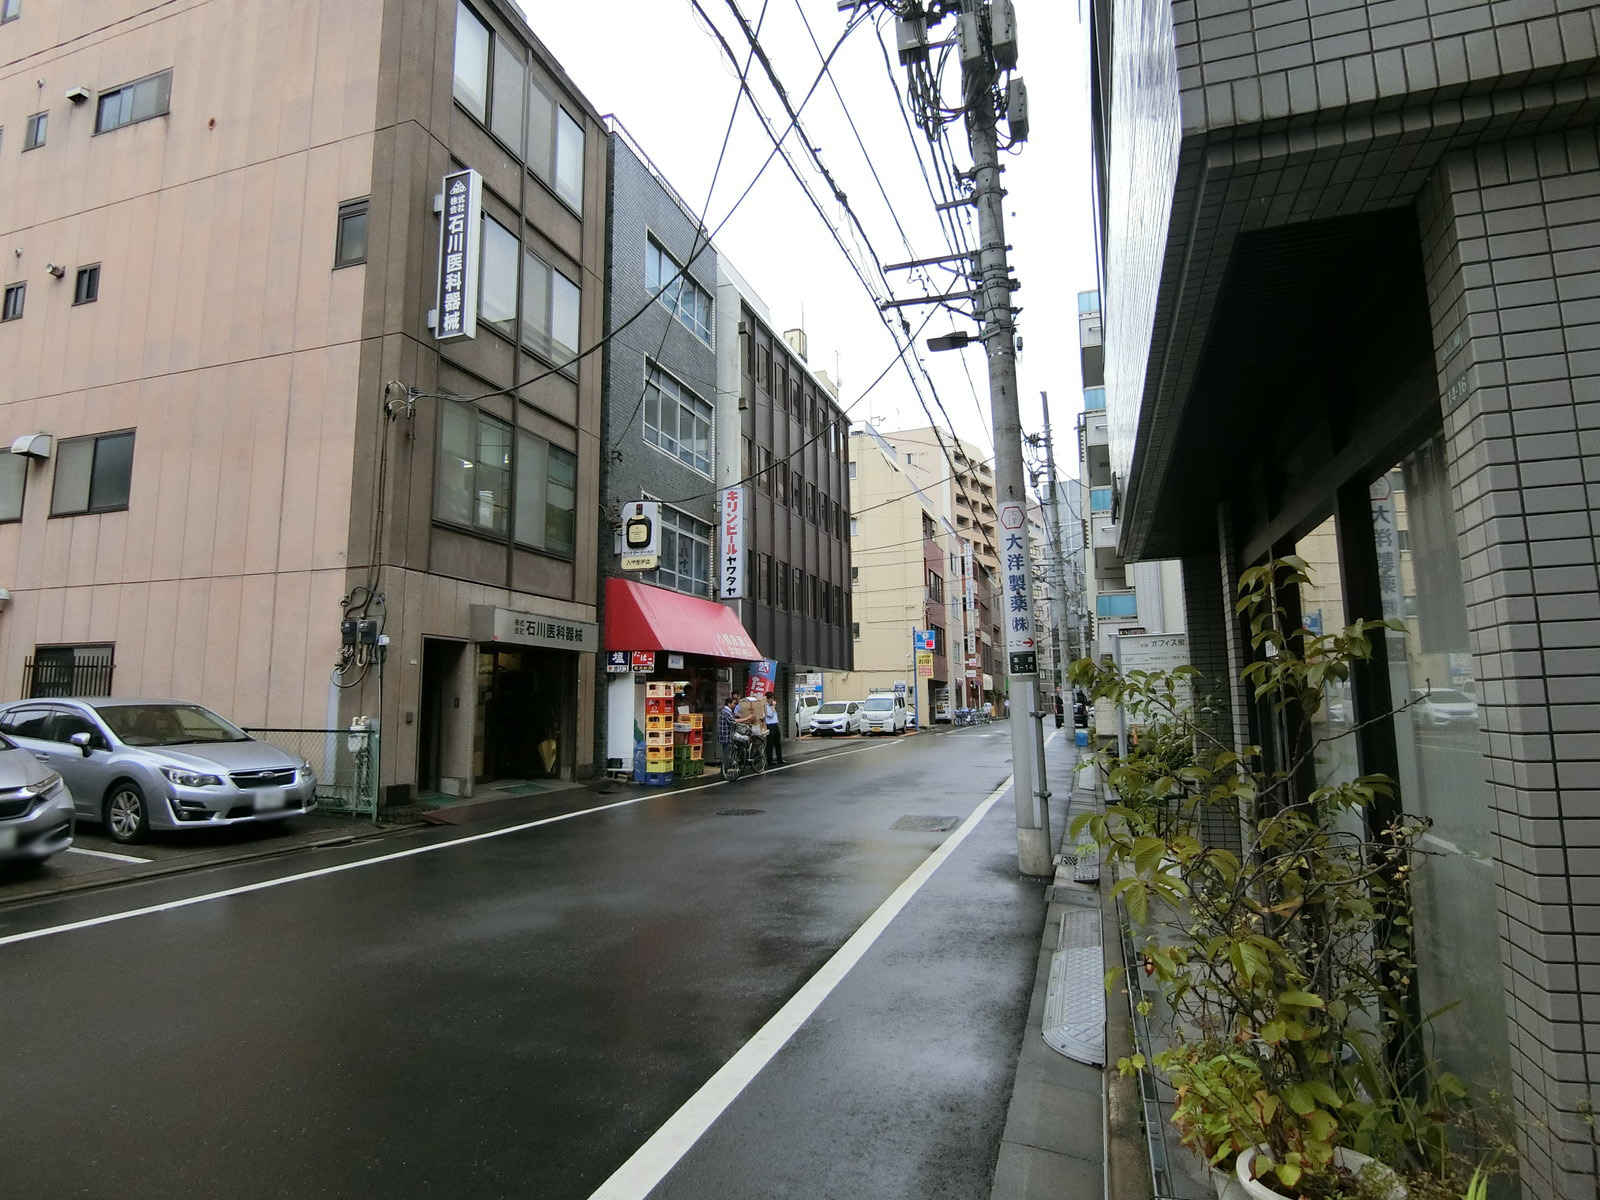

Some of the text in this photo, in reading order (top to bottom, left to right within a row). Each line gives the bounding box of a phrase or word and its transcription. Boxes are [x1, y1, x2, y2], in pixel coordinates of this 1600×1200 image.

[443, 214, 465, 331] 石川医科器械
[1447, 376, 1467, 405] 14-16
[526, 621, 583, 642] 石川医科器械
[1008, 639, 1022, 648] ここ
[611, 651, 625, 664] 塩
[633, 651, 653, 665] たばこ
[1014, 664, 1034, 672] 3-14
